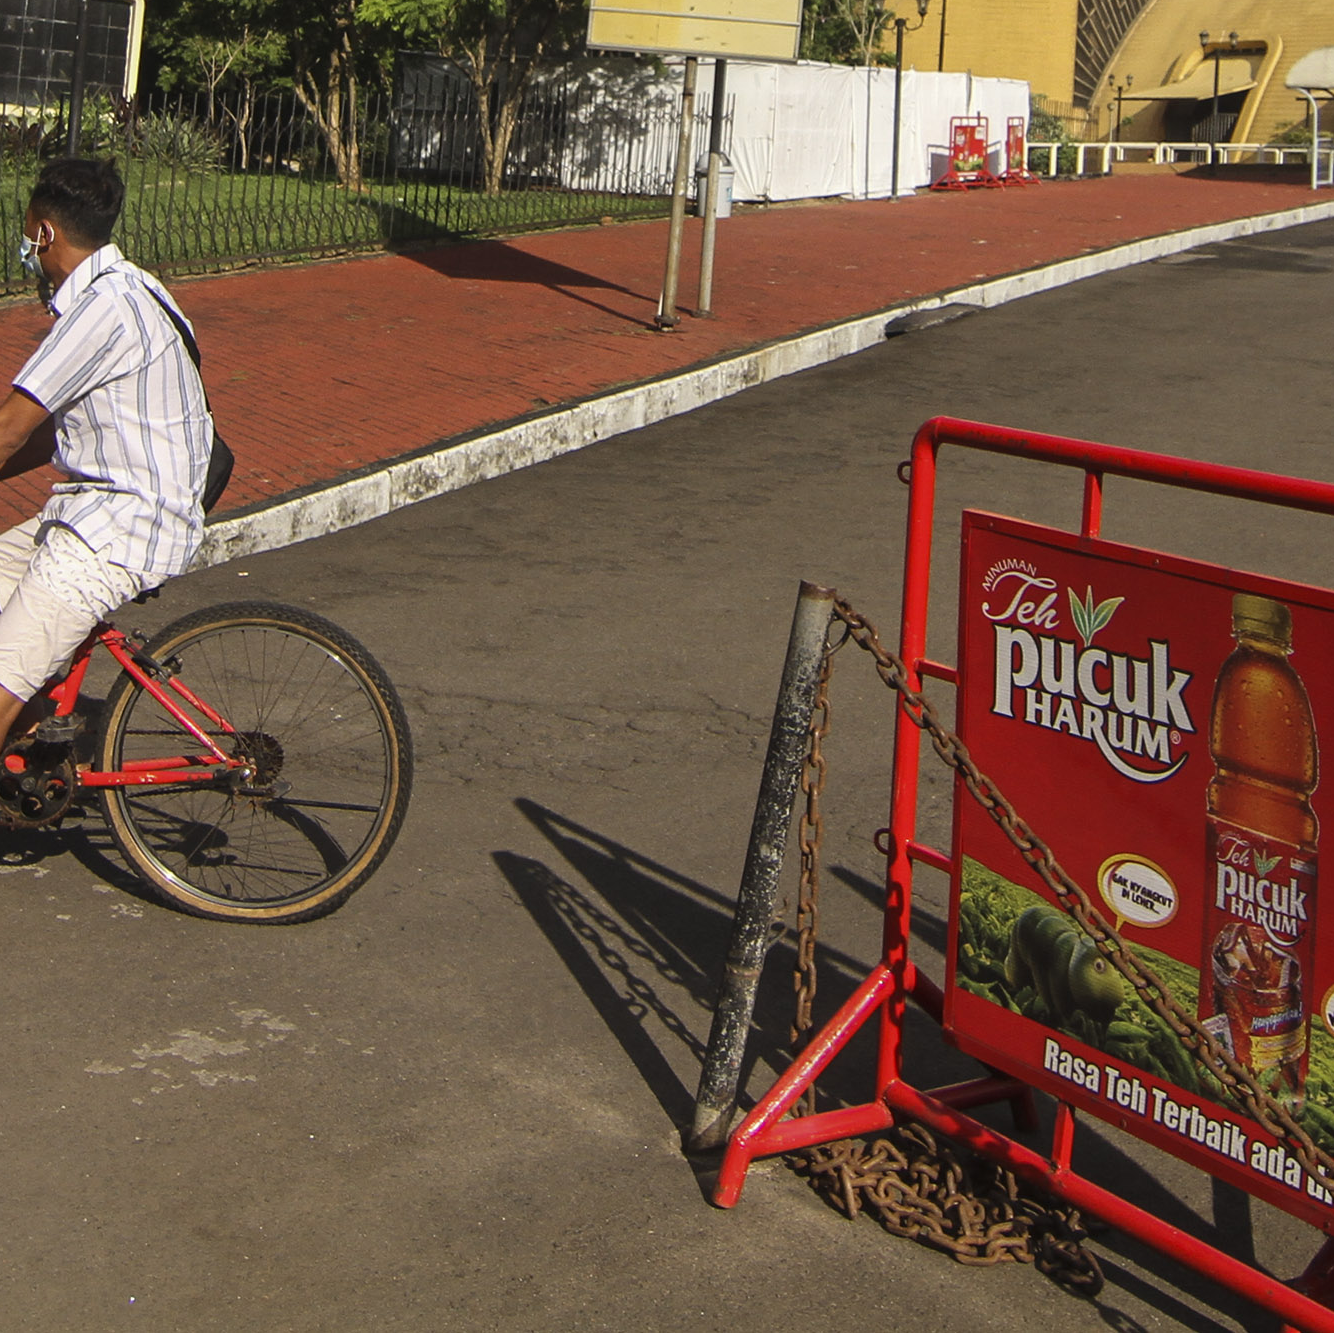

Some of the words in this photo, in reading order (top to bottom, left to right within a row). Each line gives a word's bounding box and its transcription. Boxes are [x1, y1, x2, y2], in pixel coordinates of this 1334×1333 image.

[981, 570, 1060, 630] Teh
[982, 558, 1038, 593] MINUMAN
[1024, 686, 1189, 783] HARUM
[1217, 835, 1251, 867] Teh
[1229, 896, 1307, 947] HARUM
[1043, 1037, 1101, 1094] Rasa
[1104, 1065, 1148, 1116] Teh
[1151, 1086, 1248, 1165] Terbaik
[1249, 1140, 1303, 1191] ada
